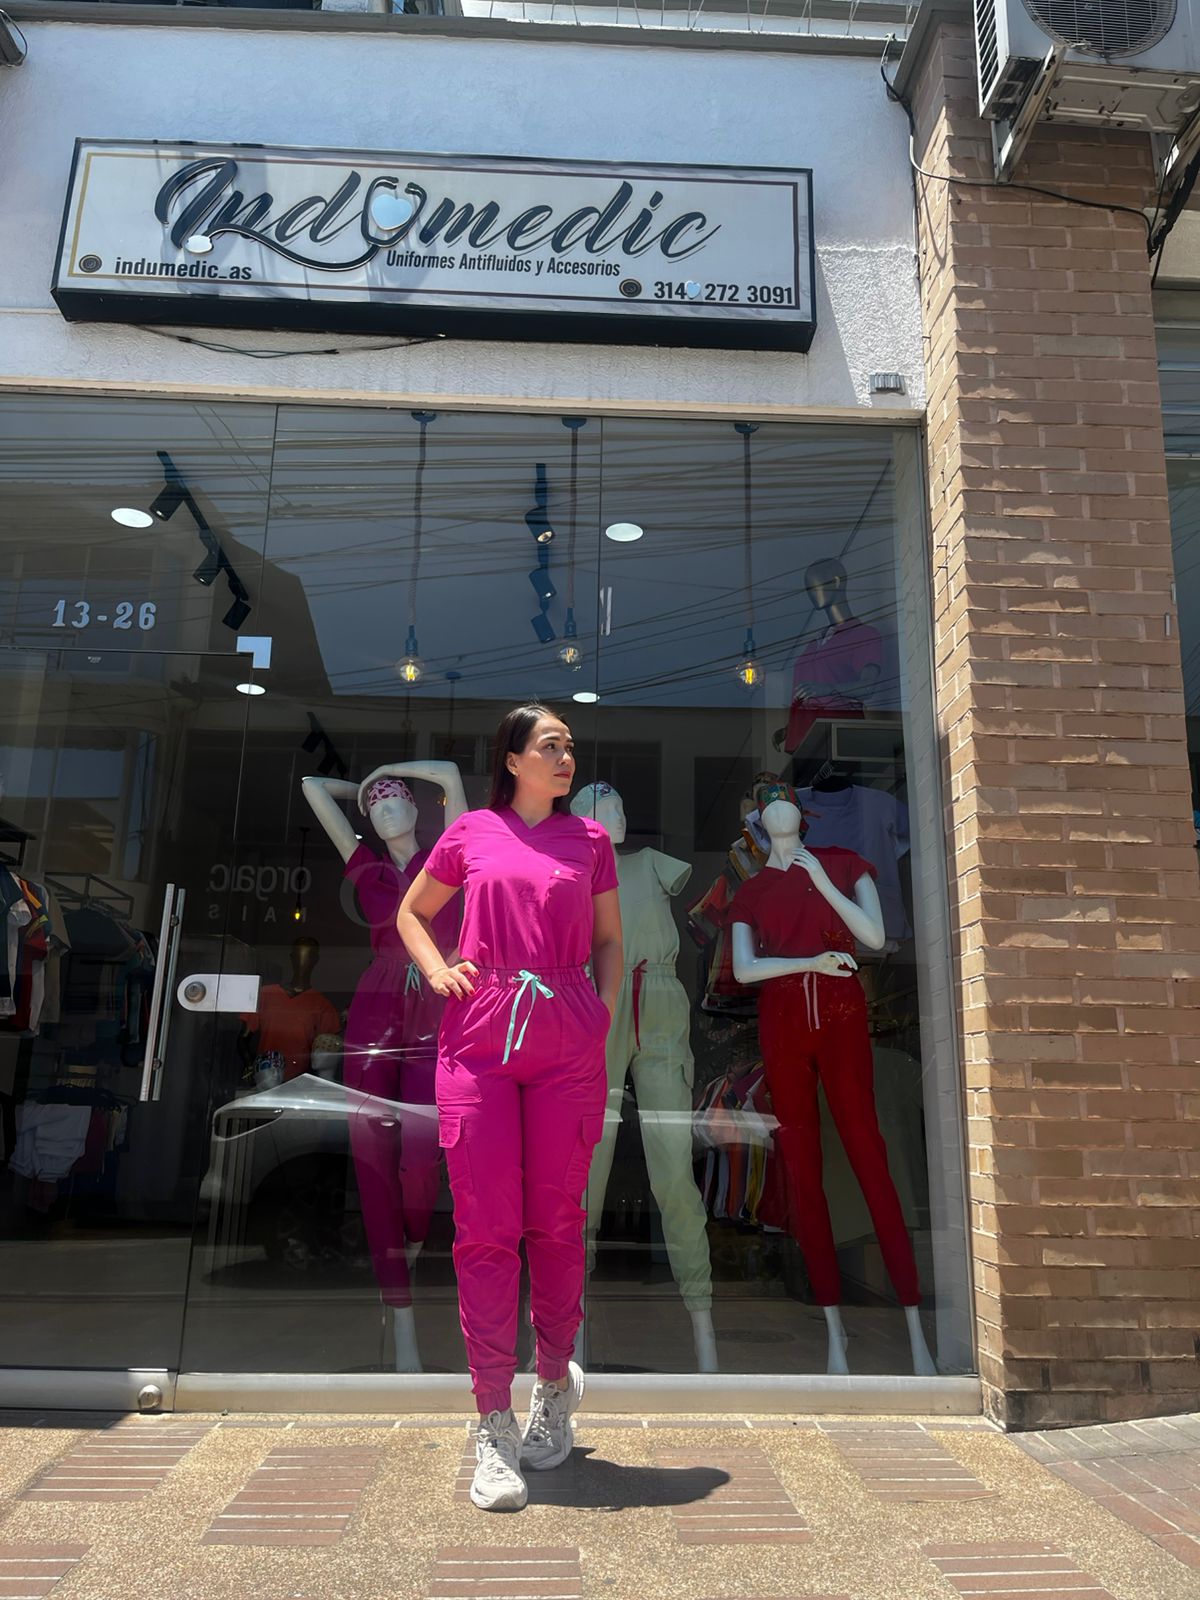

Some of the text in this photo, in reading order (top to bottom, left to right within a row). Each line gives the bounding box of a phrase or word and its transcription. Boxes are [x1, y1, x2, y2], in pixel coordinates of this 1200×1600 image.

[114, 256, 252, 280] indumedic_as
[386, 250, 621, 276] Uniformes Antifluidos y Accesorios
[653, 280, 793, 305] 314 272 3091
[52, 599, 157, 631] 13-26
